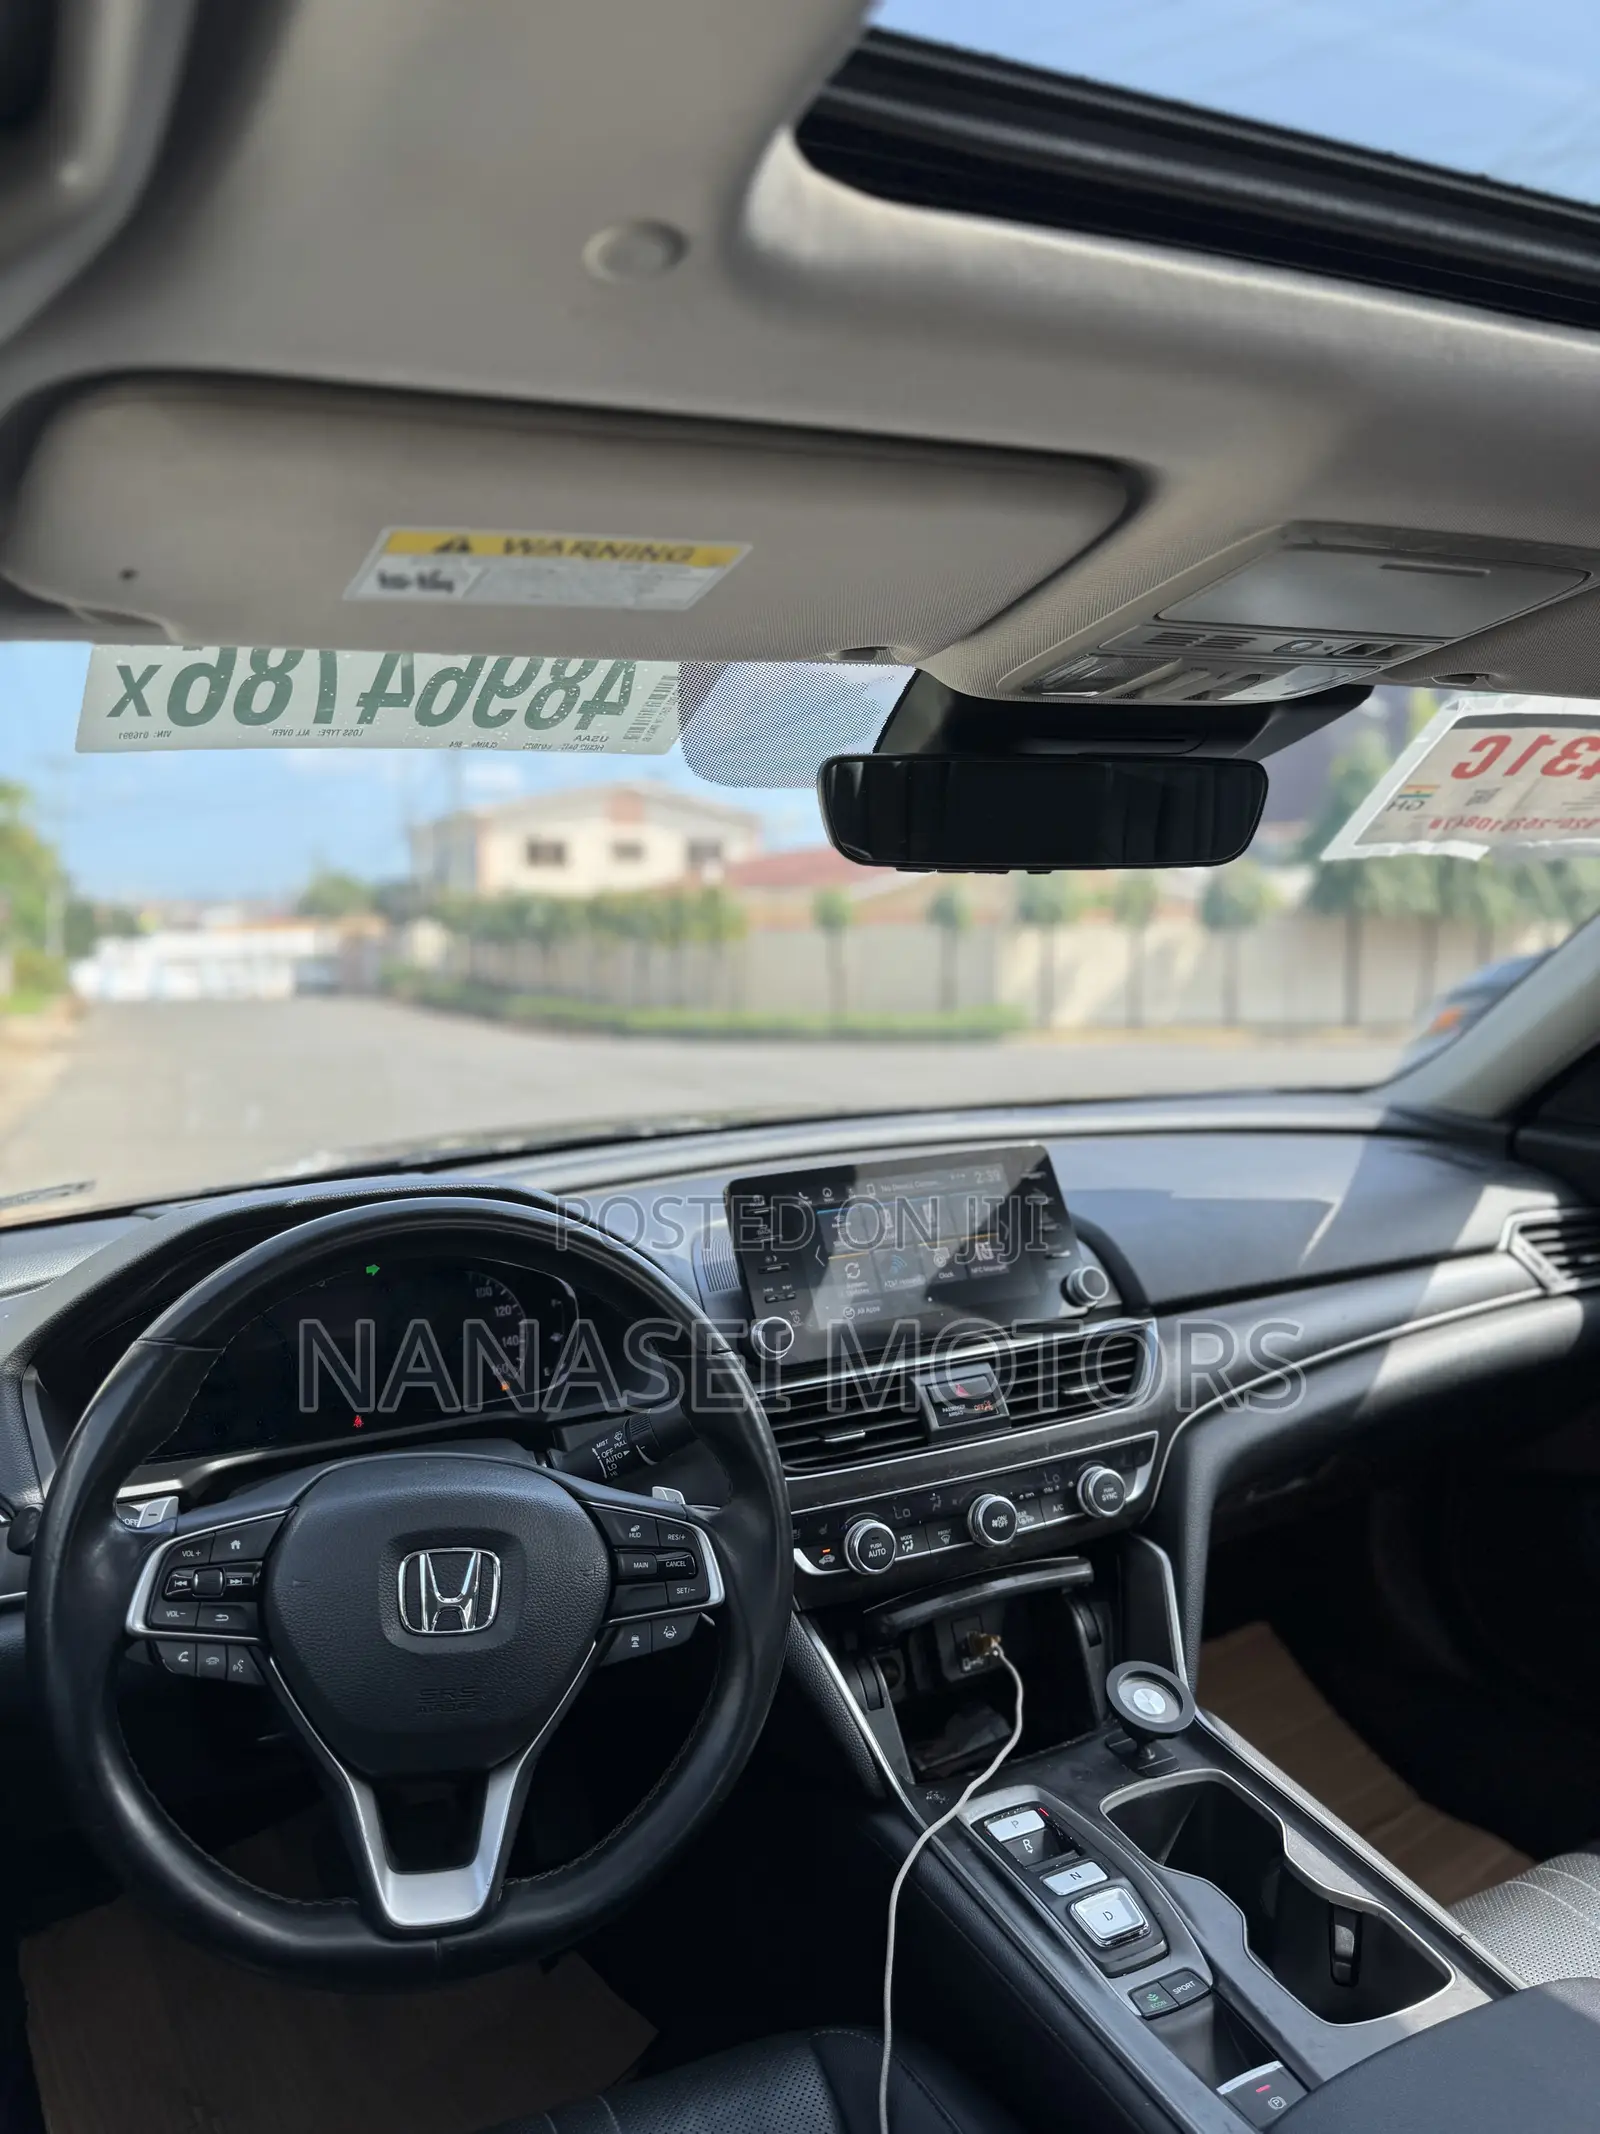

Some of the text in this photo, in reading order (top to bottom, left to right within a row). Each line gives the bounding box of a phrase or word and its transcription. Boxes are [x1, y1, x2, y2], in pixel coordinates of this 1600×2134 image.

[504, 537, 694, 561] WARNING
[494, 1304, 512, 1317] 120
[502, 1335, 519, 1347] 140
[596, 1439, 609, 1449] MIST
[601, 1448, 614, 1459] OFF
[605, 1452, 623, 1465] AUTO
[608, 1463, 618, 1472] LO
[1053, 1504, 1064, 1513] A/C
[900, 1533, 913, 1542] MODE
[868, 1548, 887, 1559] AUTO
[666, 1560, 687, 1568] CANCEL
[1010, 1819, 1019, 1829] P
[1022, 1838, 1033, 1850] R
[1070, 1871, 1082, 1881] N
[1102, 1910, 1114, 1921] D
[1172, 1980, 1196, 1995] SPORT
